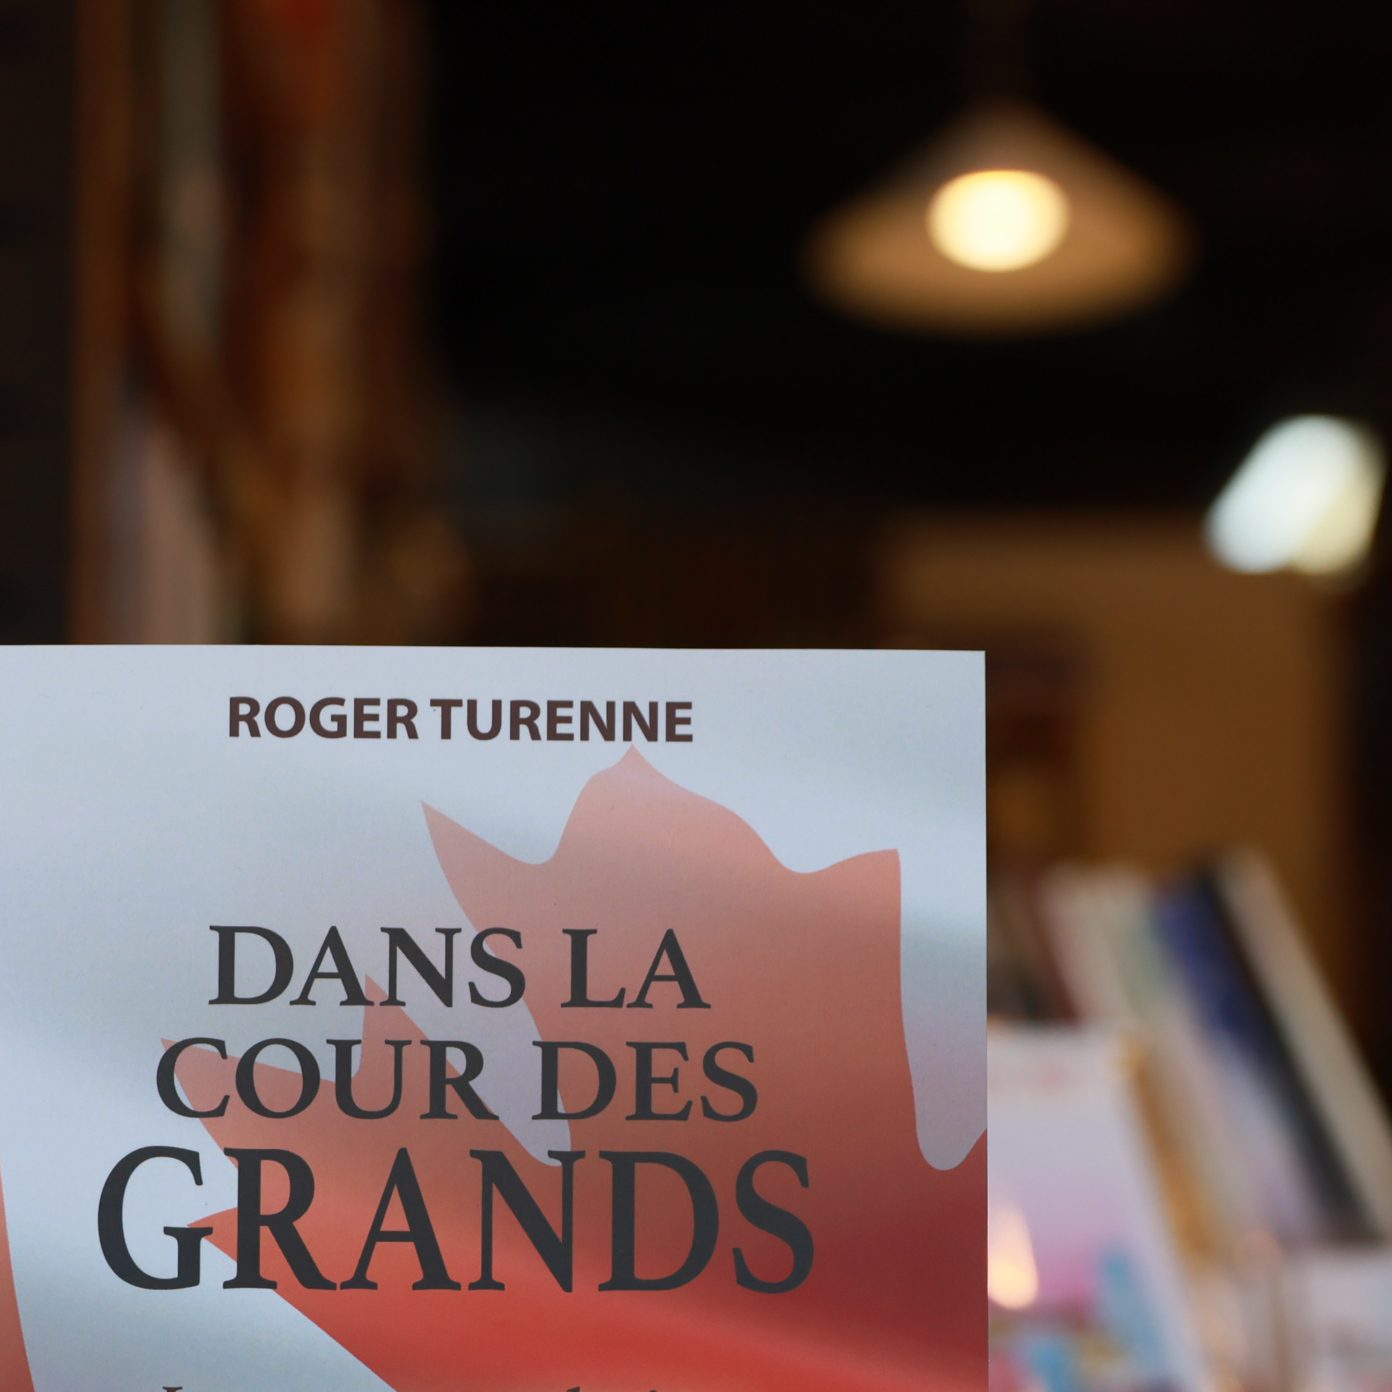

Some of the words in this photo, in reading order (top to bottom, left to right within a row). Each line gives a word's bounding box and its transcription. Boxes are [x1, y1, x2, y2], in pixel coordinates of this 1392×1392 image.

[228, 695, 419, 740] ROGER
[429, 697, 694, 743] TURENNE
[207, 923, 526, 1008] DANS
[560, 927, 712, 1010] LA
[154, 1036, 500, 1122] COUR
[531, 1039, 759, 1123] DES
[97, 1145, 814, 1293] GRANDS
